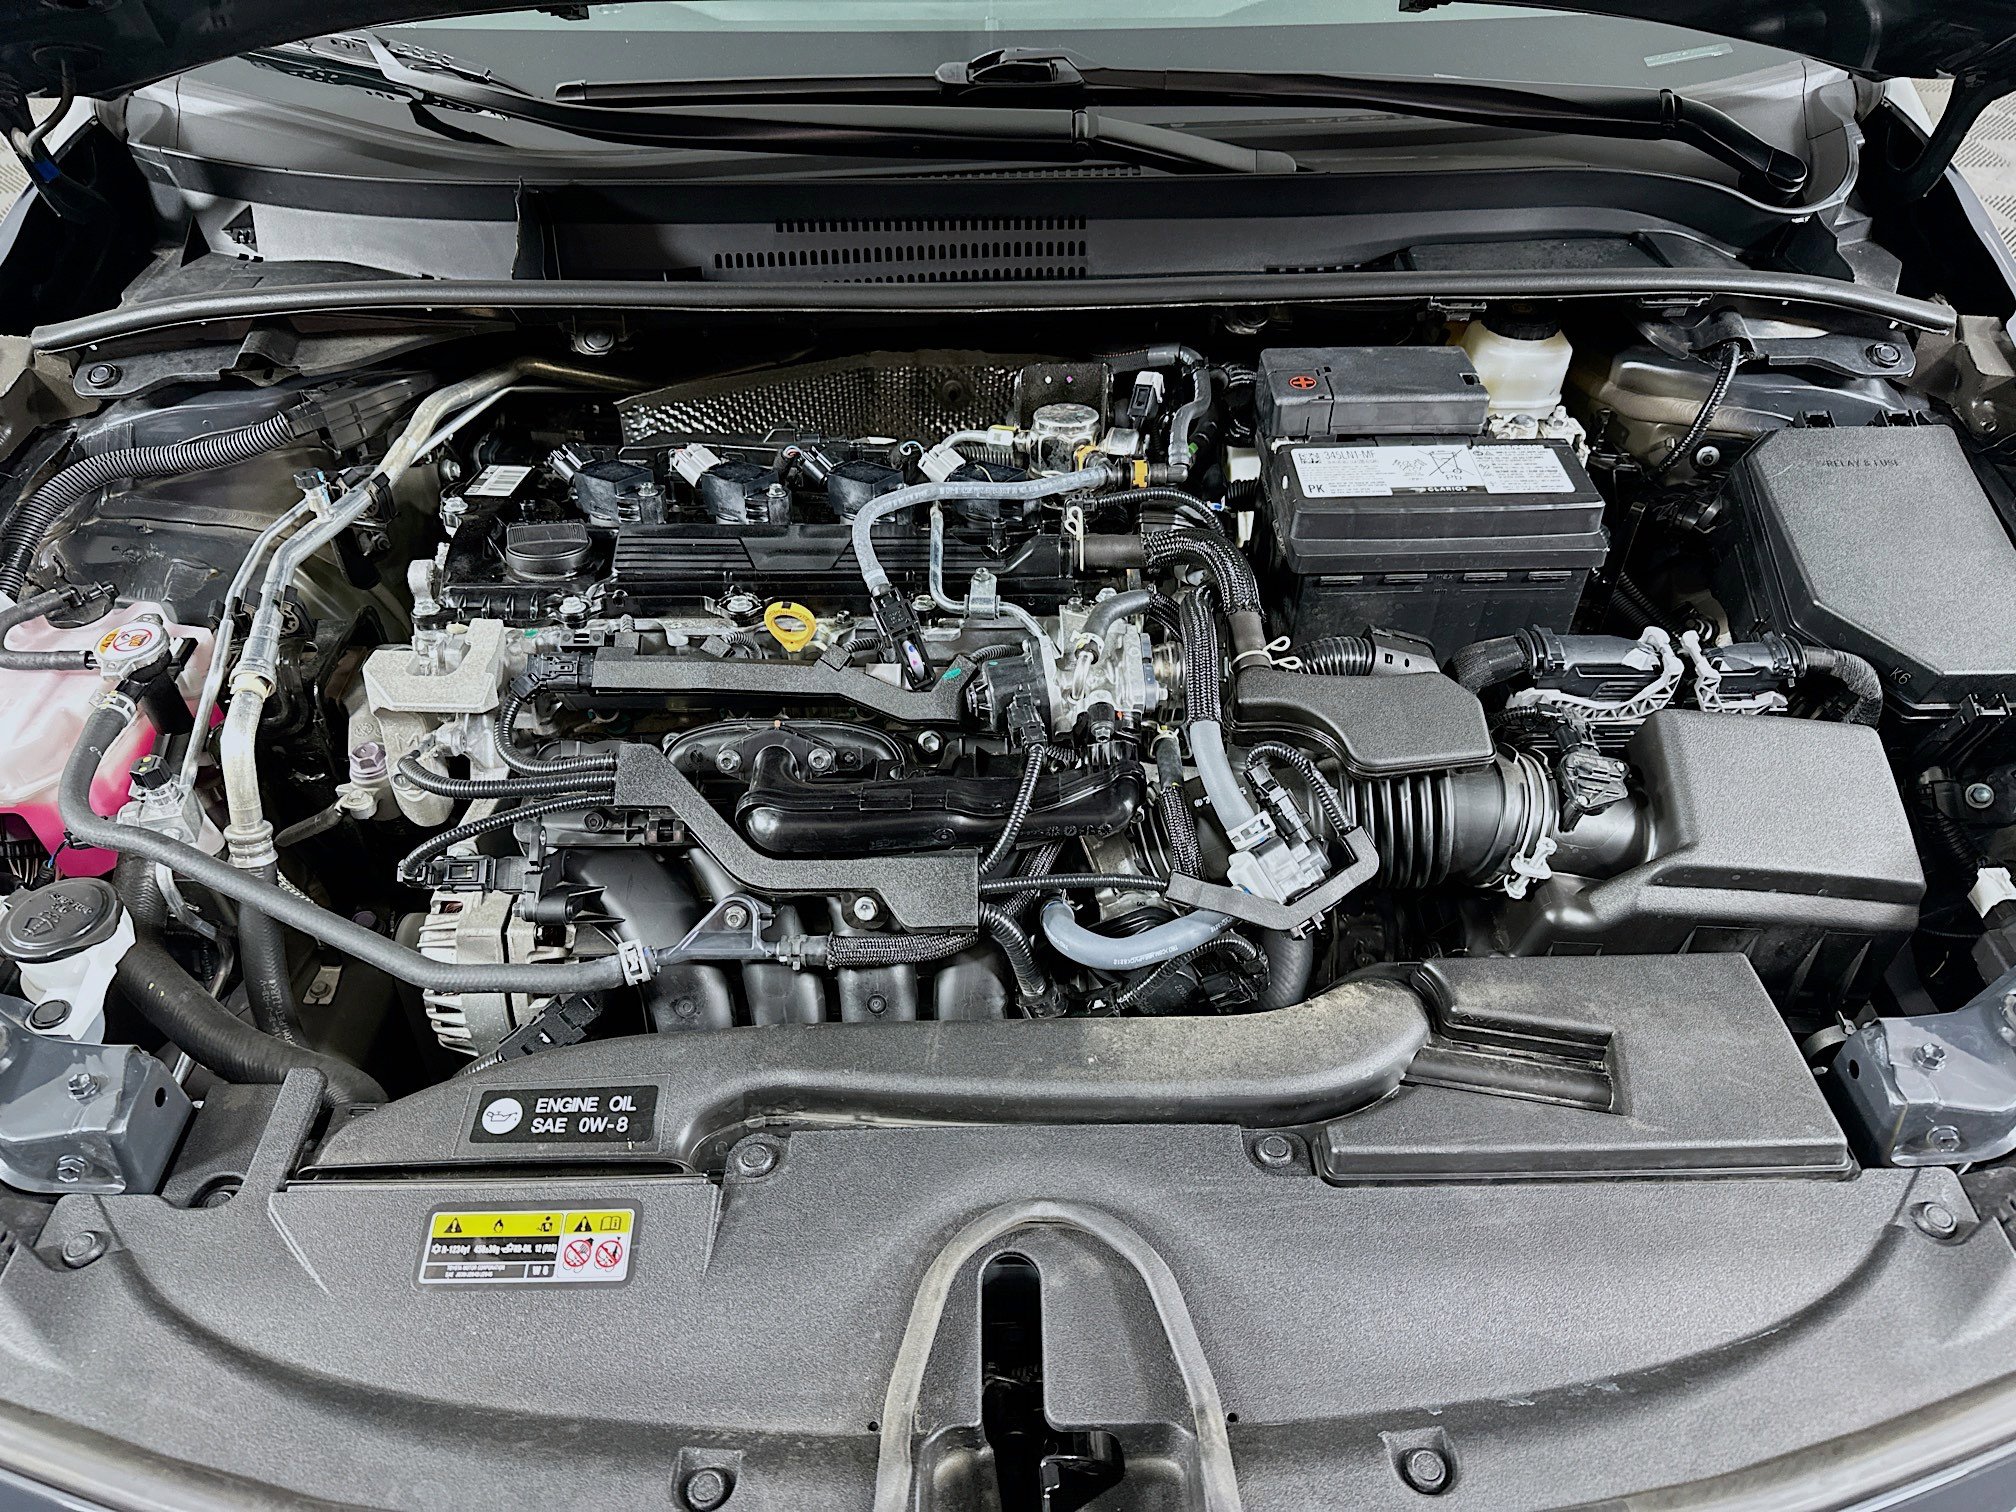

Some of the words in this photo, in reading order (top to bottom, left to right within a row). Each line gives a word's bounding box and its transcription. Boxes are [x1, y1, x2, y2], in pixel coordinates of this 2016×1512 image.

[1308, 484, 1326, 493] PK
[535, 1096, 600, 1114] ENGINE
[609, 1095, 637, 1112] OIL
[530, 1118, 568, 1134] SAE
[579, 1116, 629, 1133] 0W-8
